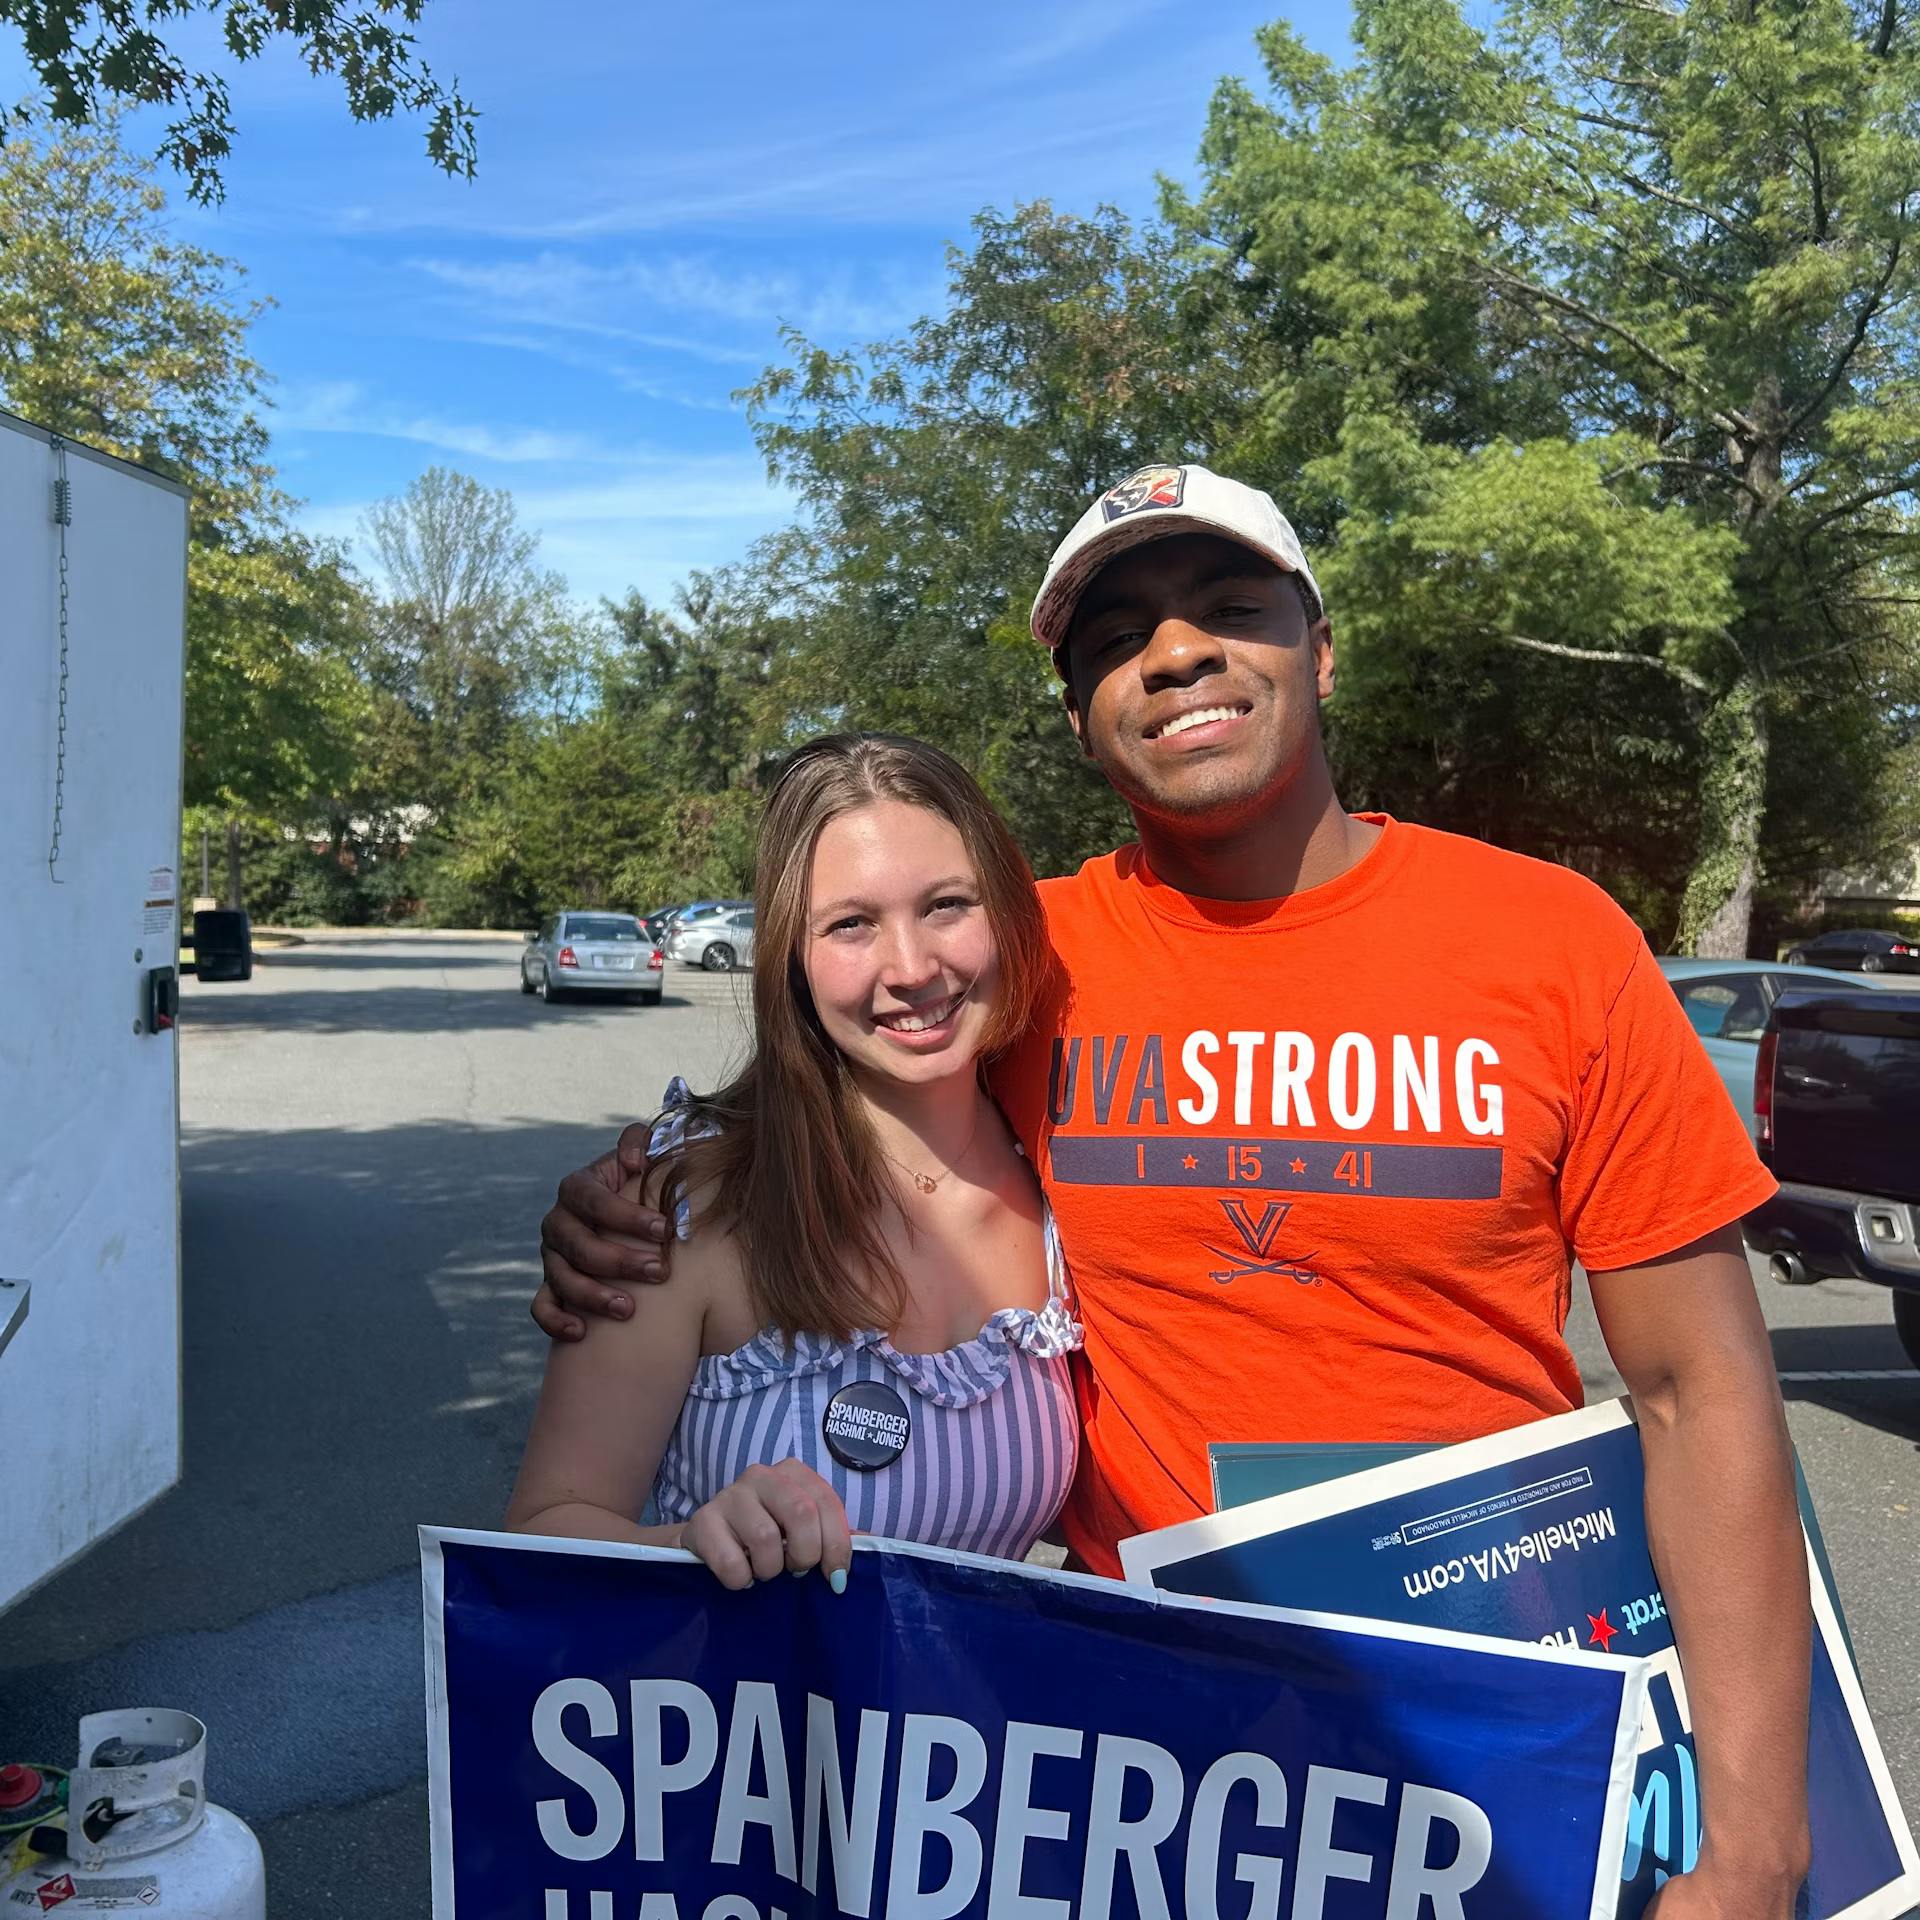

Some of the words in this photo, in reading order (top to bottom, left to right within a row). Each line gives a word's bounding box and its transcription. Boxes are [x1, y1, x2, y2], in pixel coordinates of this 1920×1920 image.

[1227, 1145, 1263, 1182] 15
[1333, 1151, 1372, 1189] 41
[829, 1401, 908, 1435] SPANBERGER
[825, 1419, 867, 1440] HASHMI
[872, 1431, 905, 1449] JONES
[1547, 1481, 1561, 1492] AND
[1560, 1478, 1572, 1488] FOR
[1570, 1474, 1583, 1485] PAID
[1509, 1495, 1517, 1505] BY
[1515, 1485, 1550, 1503] AUTHORIZED
[1477, 1505, 1487, 1515] OF
[1485, 1498, 1510, 1512] FRIENDS
[1449, 1508, 1478, 1524] MICHELLE
[1410, 1516, 1451, 1537] MALDONADO
[1403, 1507, 1616, 1598] Michelle4VA.com
[532, 1677, 1493, 1920] SPANBERGER
